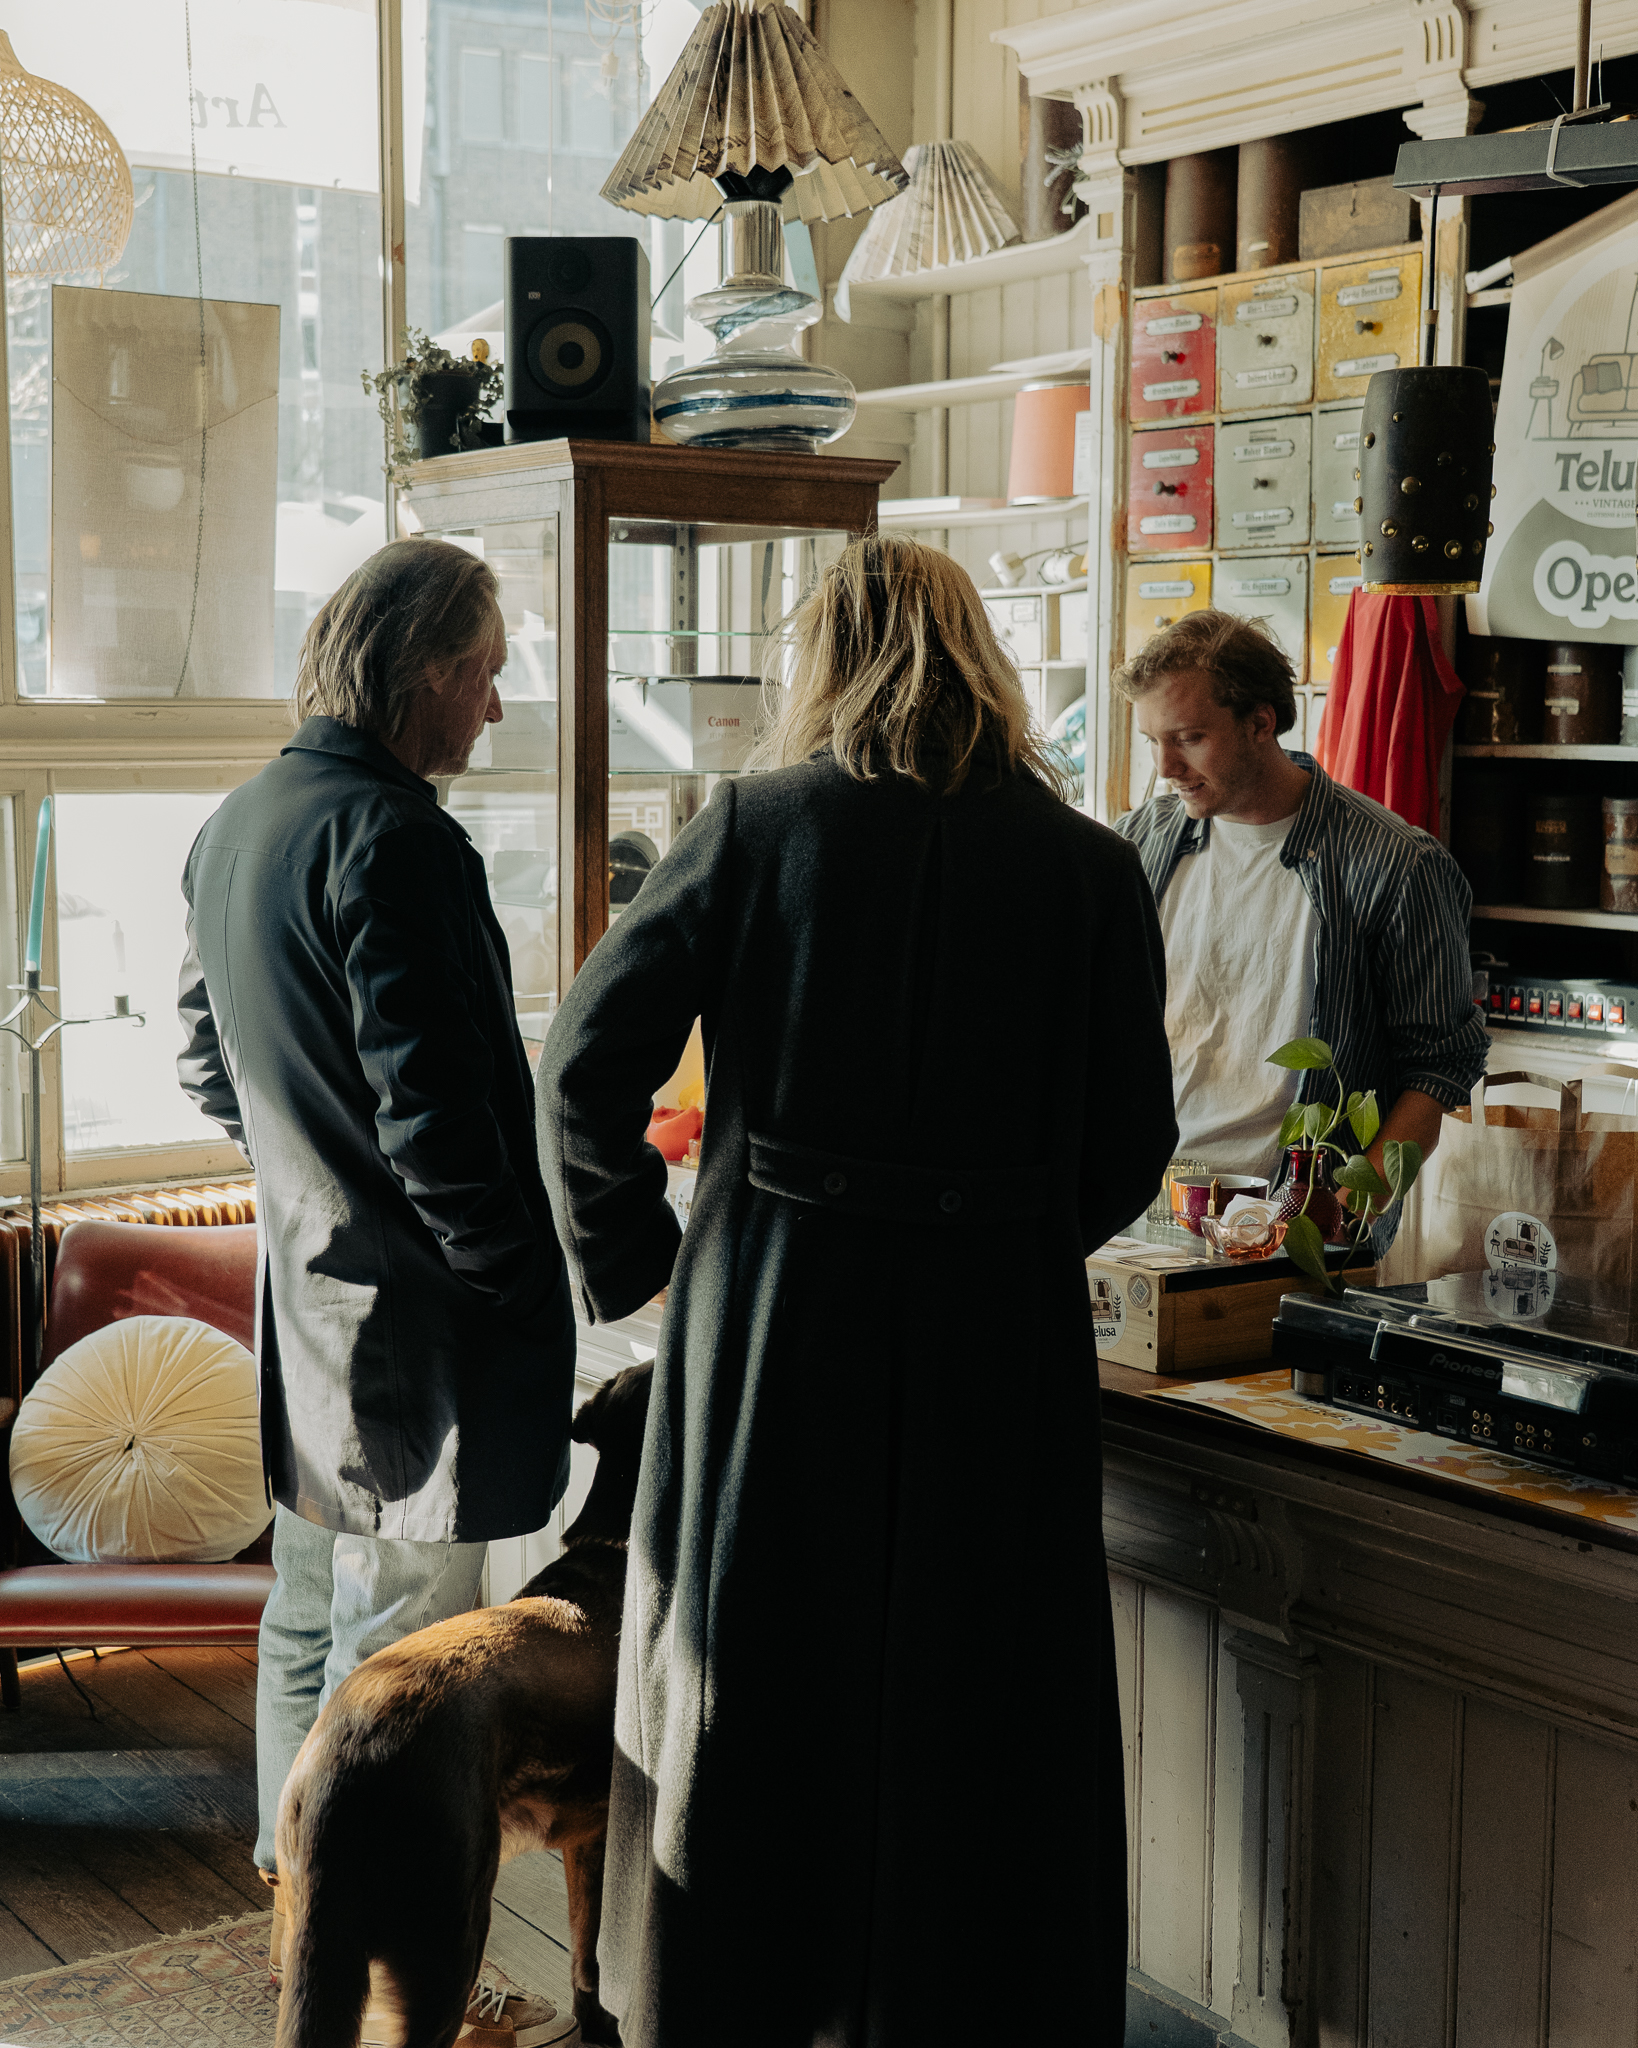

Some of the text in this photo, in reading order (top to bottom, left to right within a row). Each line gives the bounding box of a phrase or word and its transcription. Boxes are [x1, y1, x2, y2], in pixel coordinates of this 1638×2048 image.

[1555, 449, 1636, 492] Telu
[1547, 556, 1636, 612] Ope
[708, 716, 740, 727] Canon
[1094, 1325, 1117, 1338] elusa
[1428, 1352, 1503, 1381] Pioneer
